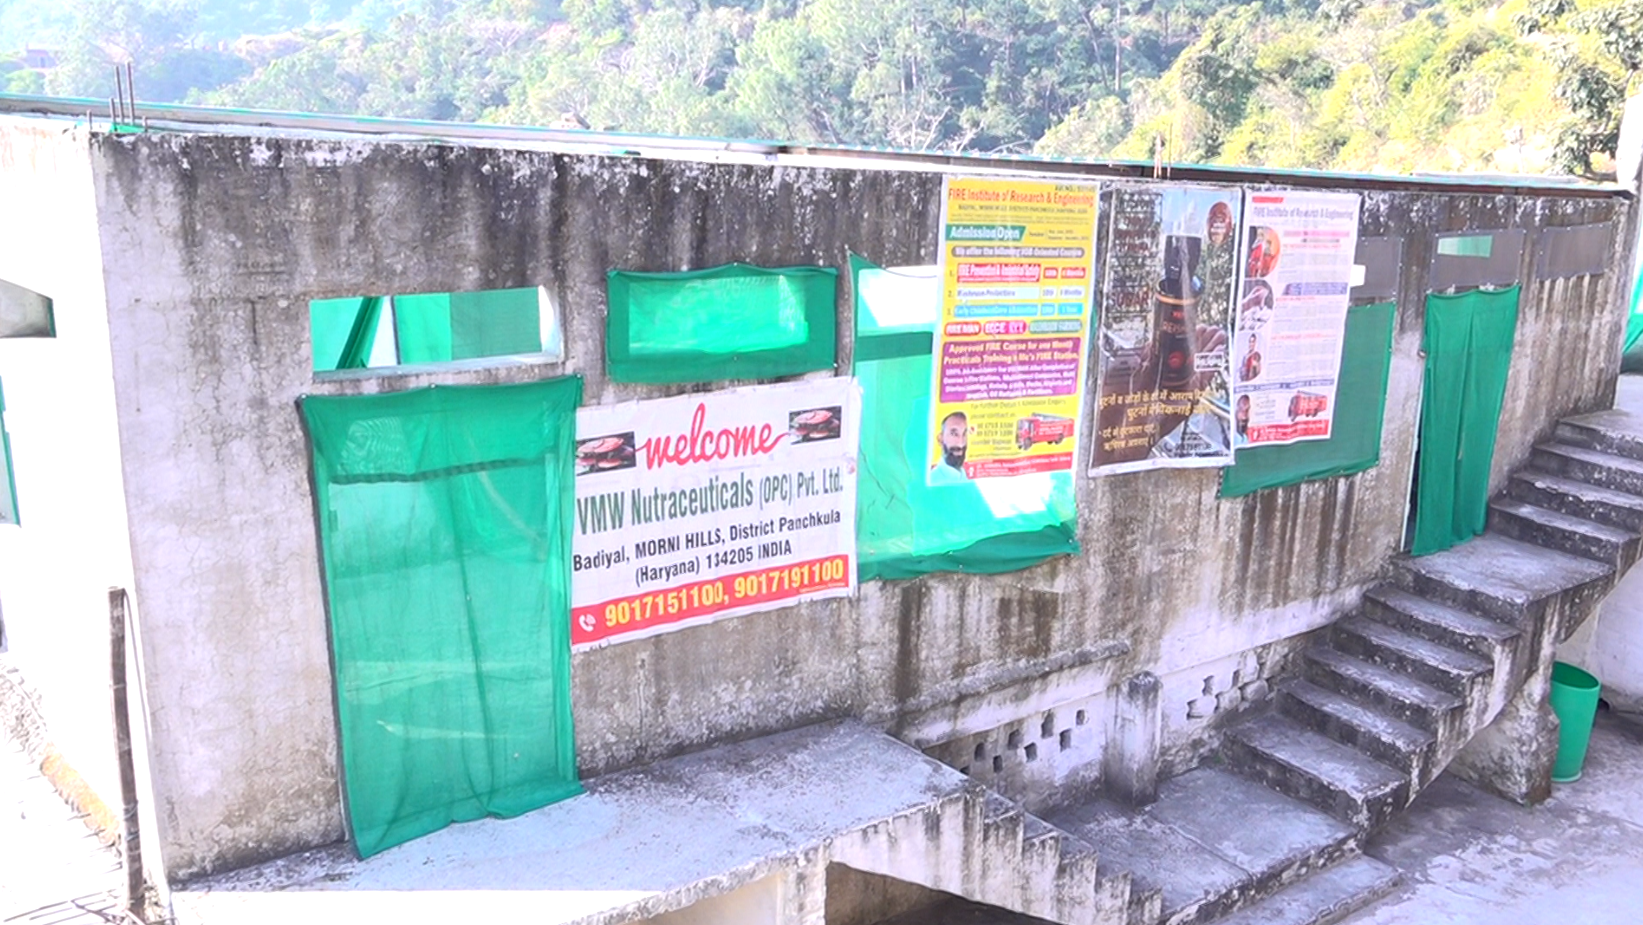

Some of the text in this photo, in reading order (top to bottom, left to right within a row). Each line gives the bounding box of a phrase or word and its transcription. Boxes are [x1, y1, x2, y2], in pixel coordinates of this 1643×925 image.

[949, 188, 966, 202] FIRE
[968, 189, 1001, 203] Institute
[1010, 190, 1045, 204] Research
[951, 226, 996, 241] Admission
[997, 227, 1020, 242] Open
[949, 344, 984, 355] Approved
[985, 343, 1001, 351] FIRE
[983, 355, 1012, 365] Training
[1036, 353, 1052, 361] FIRE
[636, 403, 789, 470] welcome
[577, 466, 844, 536] VMW Nutraceuticals (OPC) Pvt. Ltd.
[573, 509, 841, 572] Badiyal, MORNI HILLS, District Panchkula
[635, 539, 792, 588] (Haryana) 134205 INDIA
[605, 558, 844, 627] 9017151100, 9017191100
